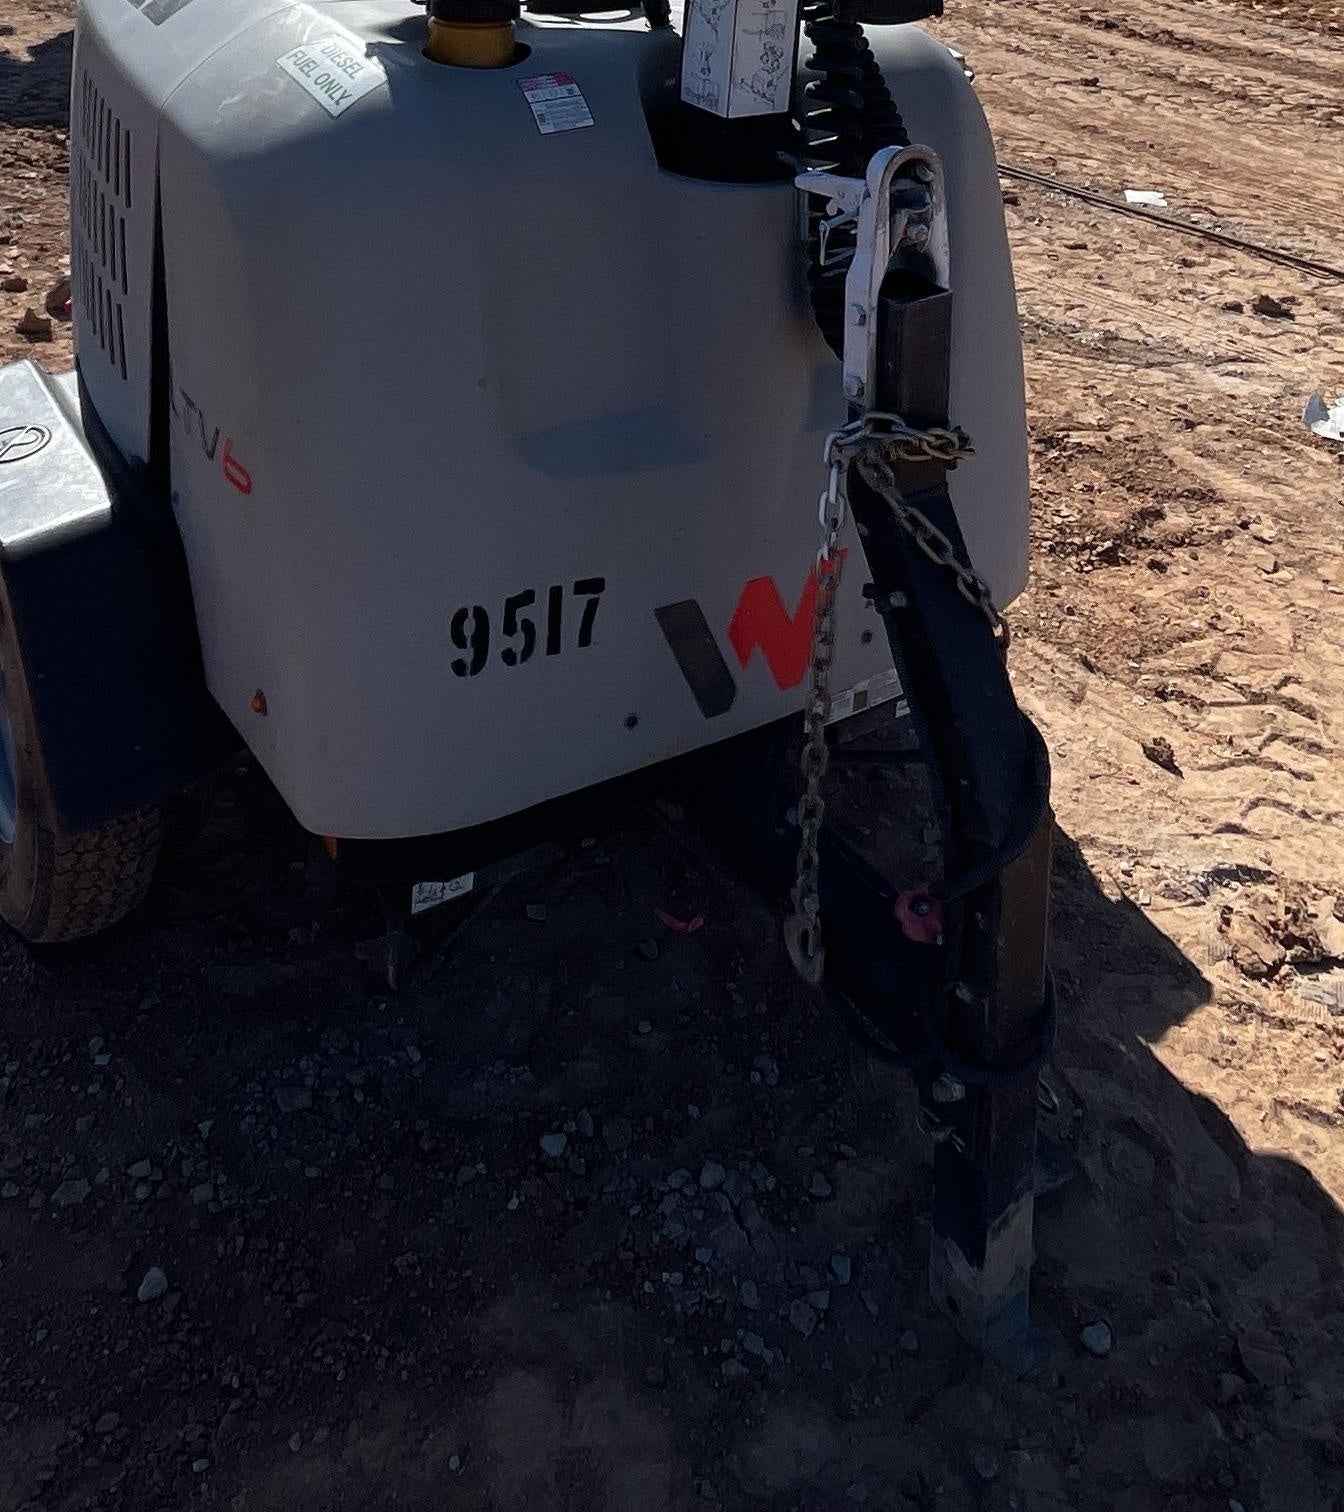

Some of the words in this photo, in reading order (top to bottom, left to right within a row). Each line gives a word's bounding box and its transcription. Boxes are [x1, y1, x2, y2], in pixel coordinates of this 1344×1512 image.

[286, 50, 320, 78] FUEL
[313, 72, 353, 106] ONLY
[319, 44, 364, 80] DIESEL
[449, 575, 607, 678] 9517
